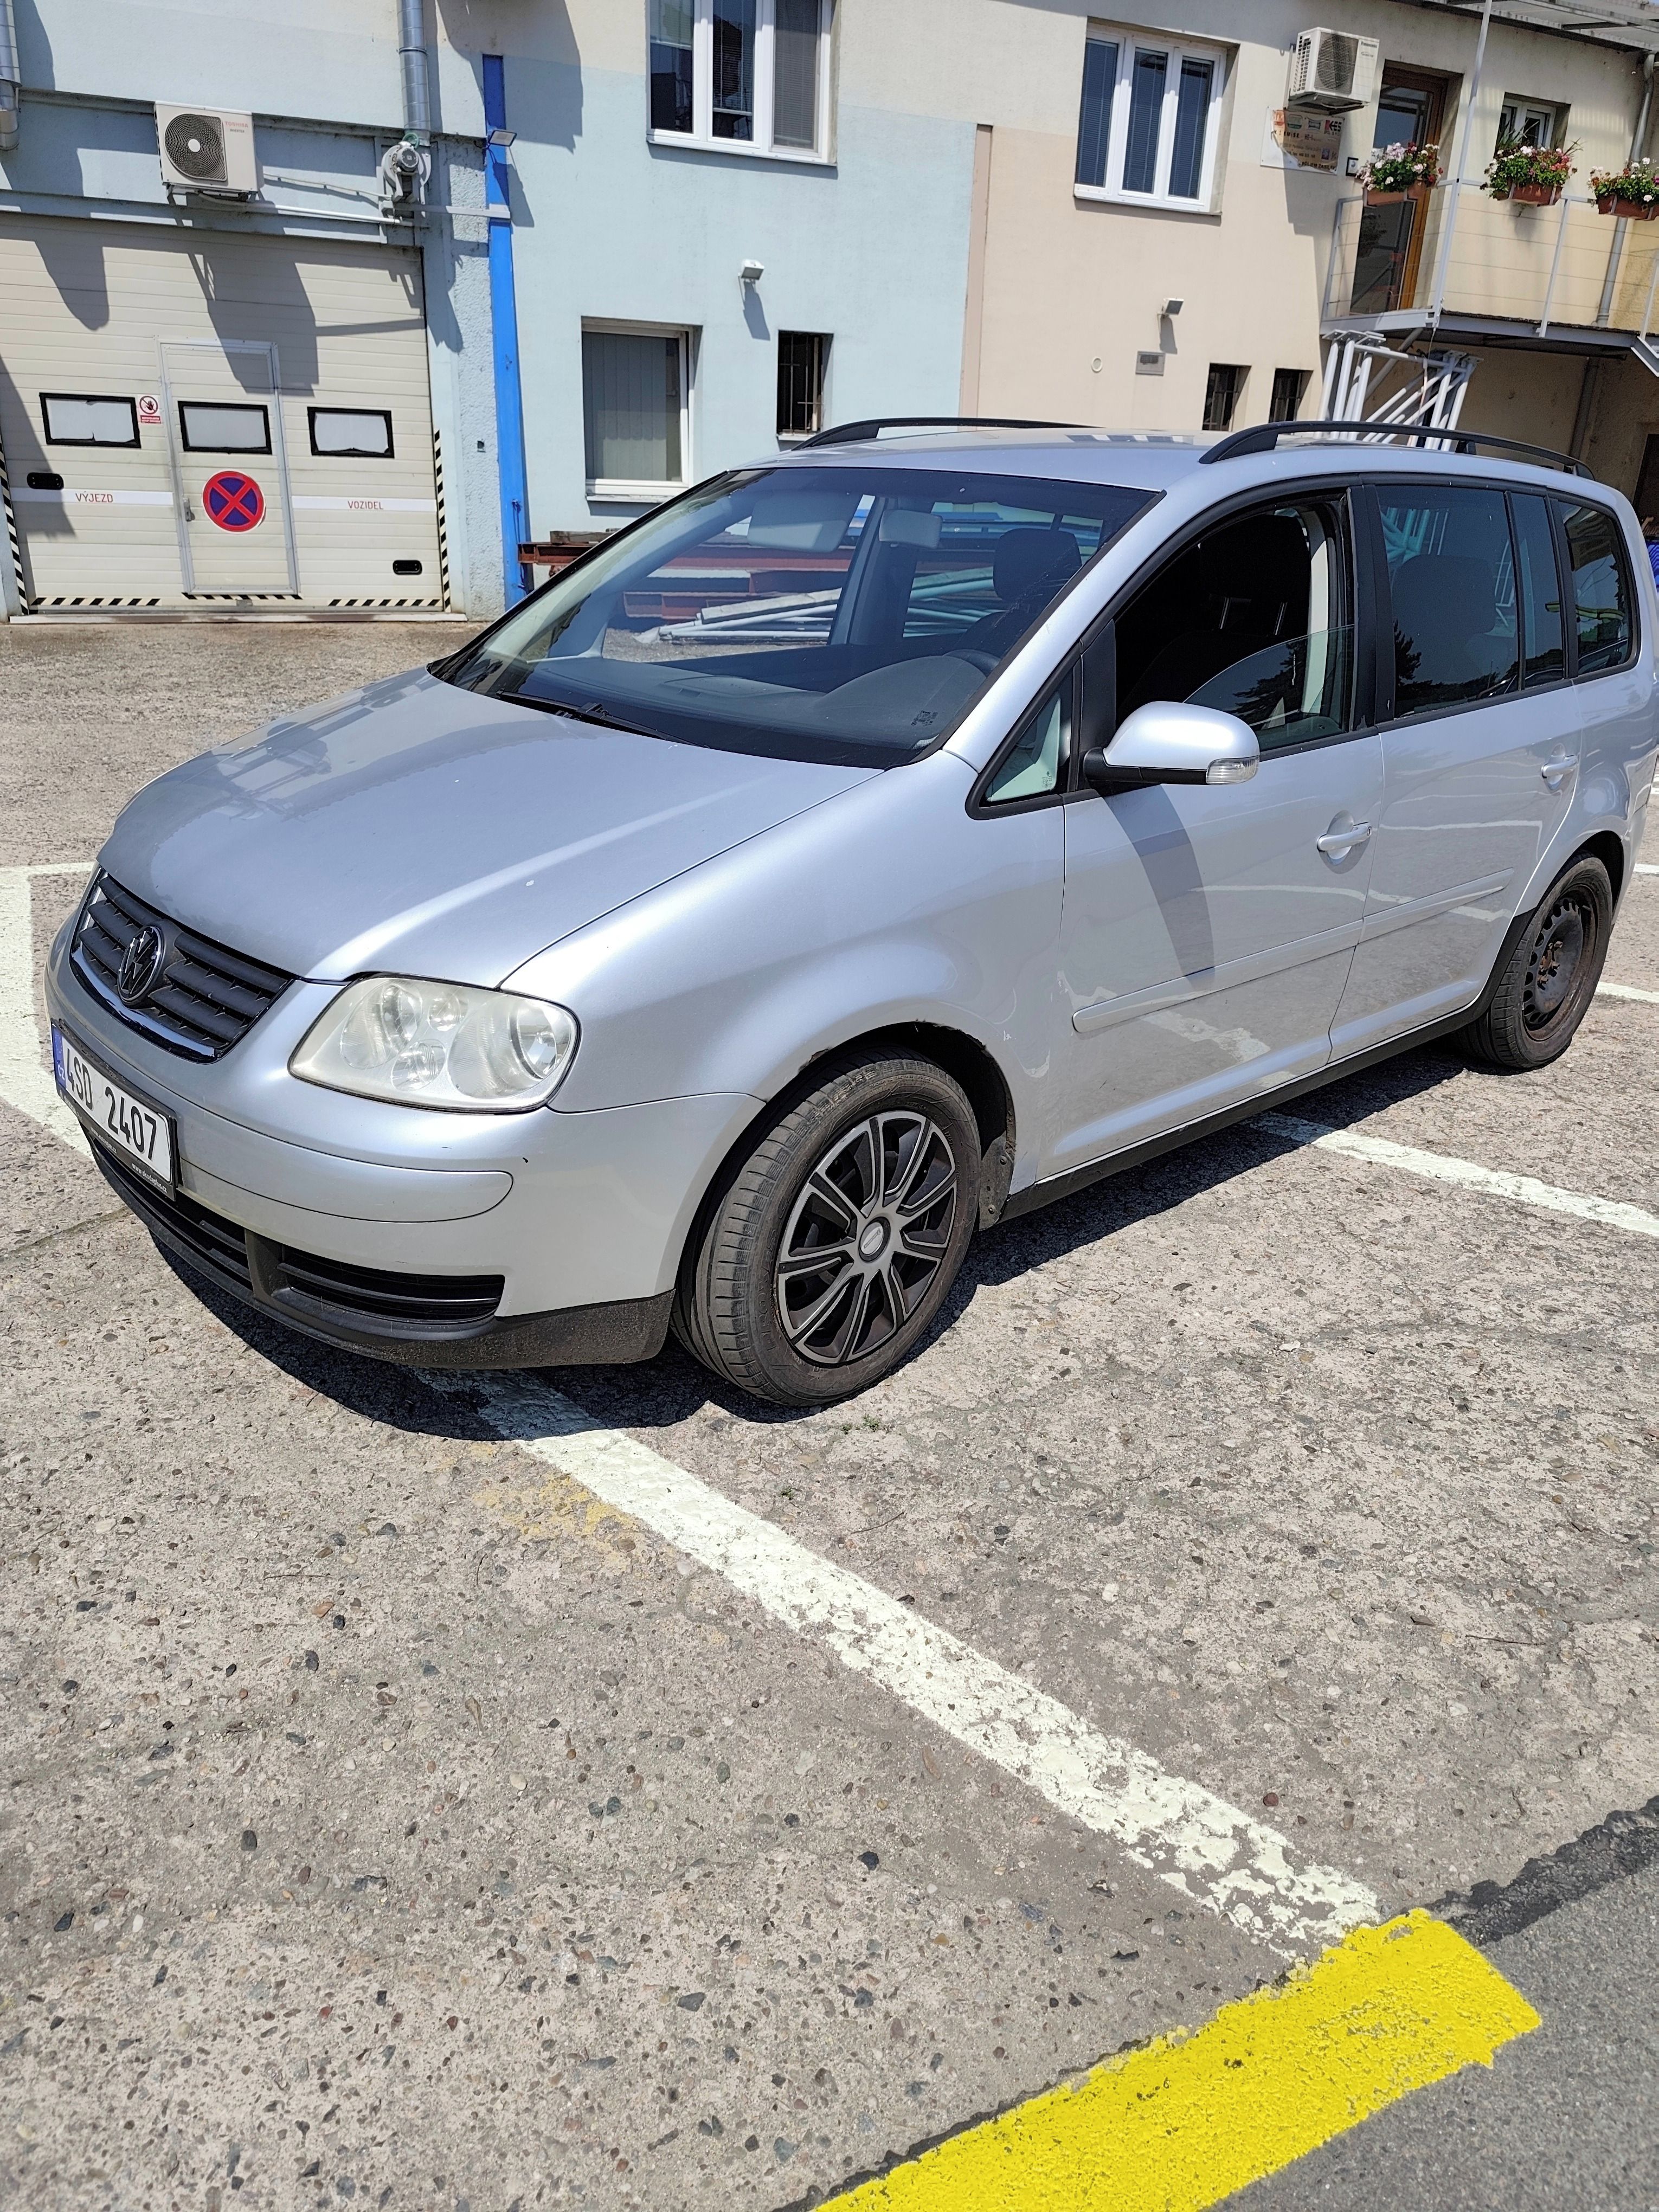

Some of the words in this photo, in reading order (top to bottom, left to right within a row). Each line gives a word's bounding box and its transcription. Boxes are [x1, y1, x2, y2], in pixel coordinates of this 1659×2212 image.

[75, 491, 113, 503] VÝJEZD
[348, 500, 384, 510] VOZIDEL
[57, 1064, 66, 1081] CZ
[67, 1047, 93, 1110] 4SD
[105, 1086, 157, 1161] 2407
